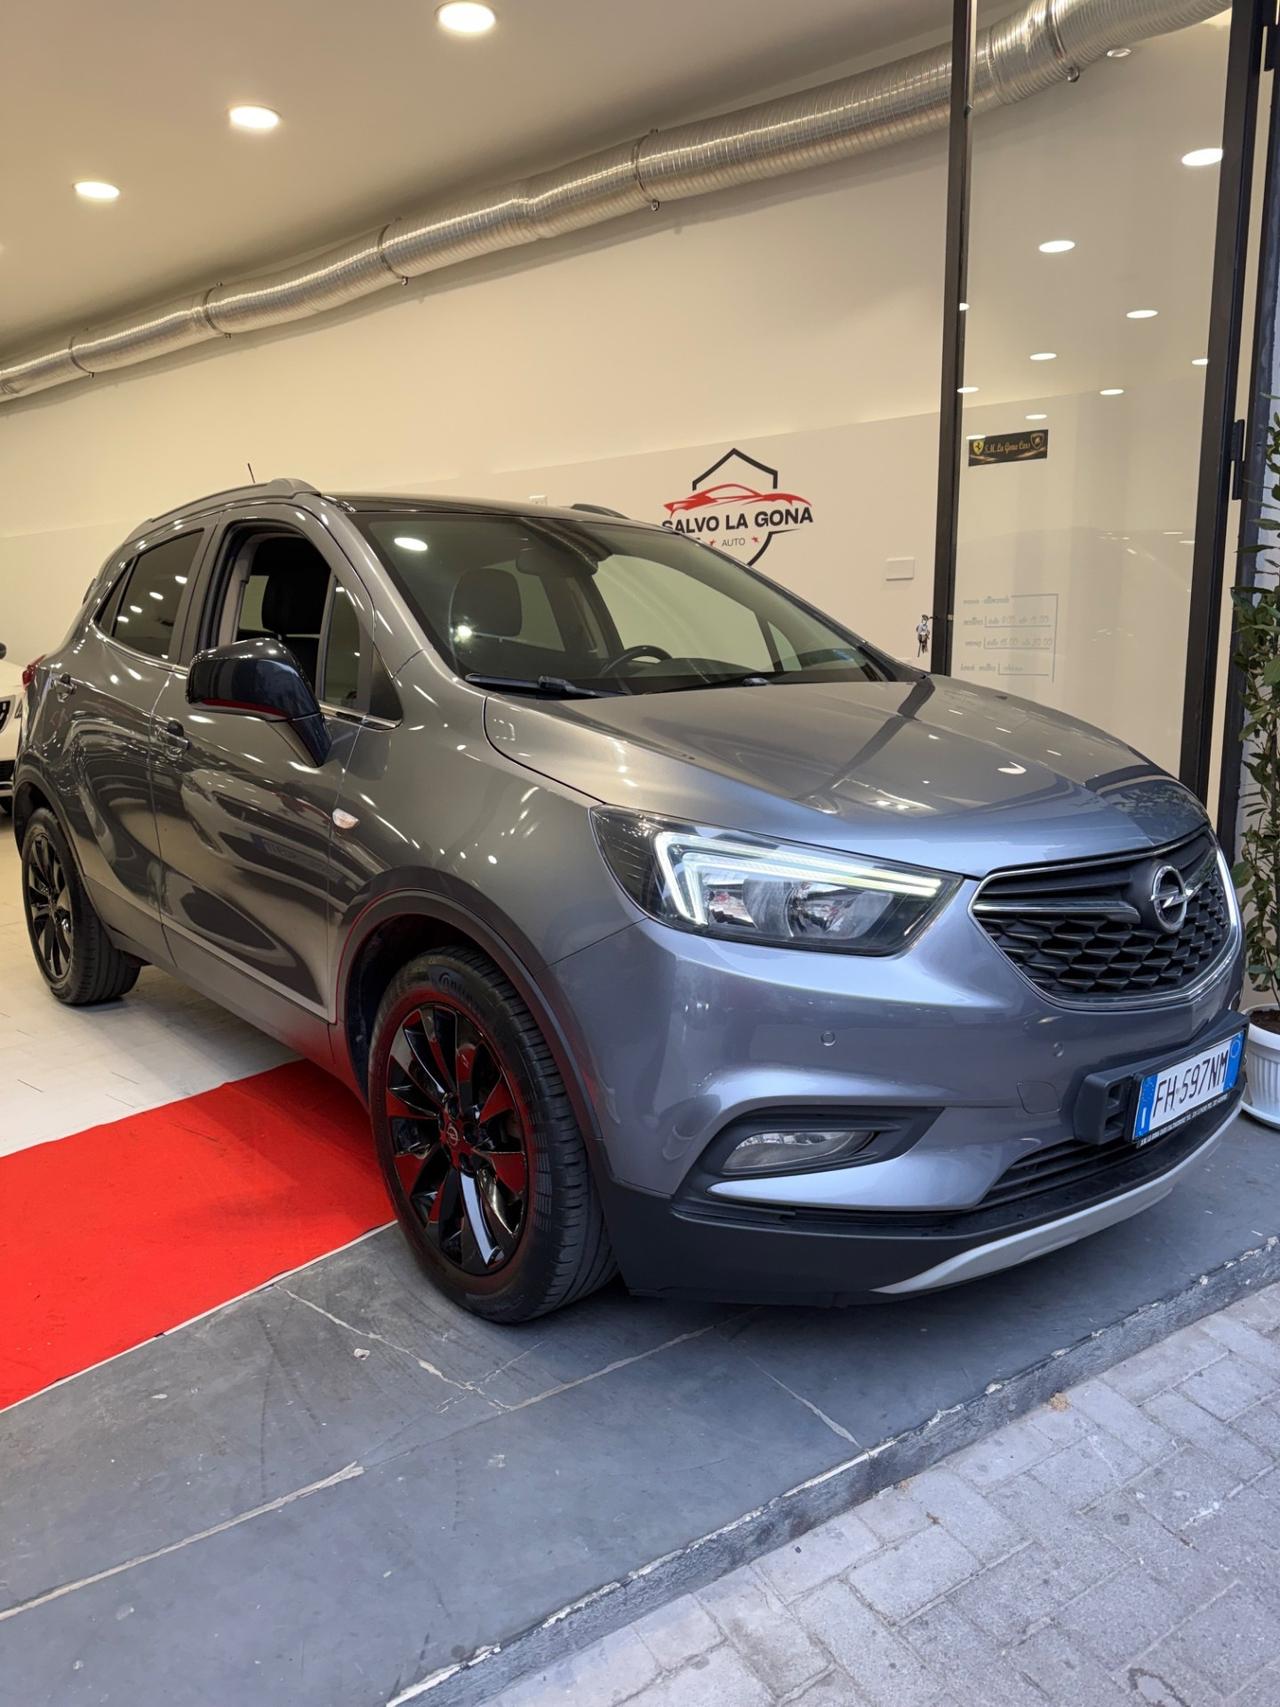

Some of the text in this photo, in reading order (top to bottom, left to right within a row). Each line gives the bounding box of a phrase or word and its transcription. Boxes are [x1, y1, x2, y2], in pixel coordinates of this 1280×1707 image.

[662, 507, 814, 534] SALVO LA GONA
[721, 537, 746, 547] AUTO
